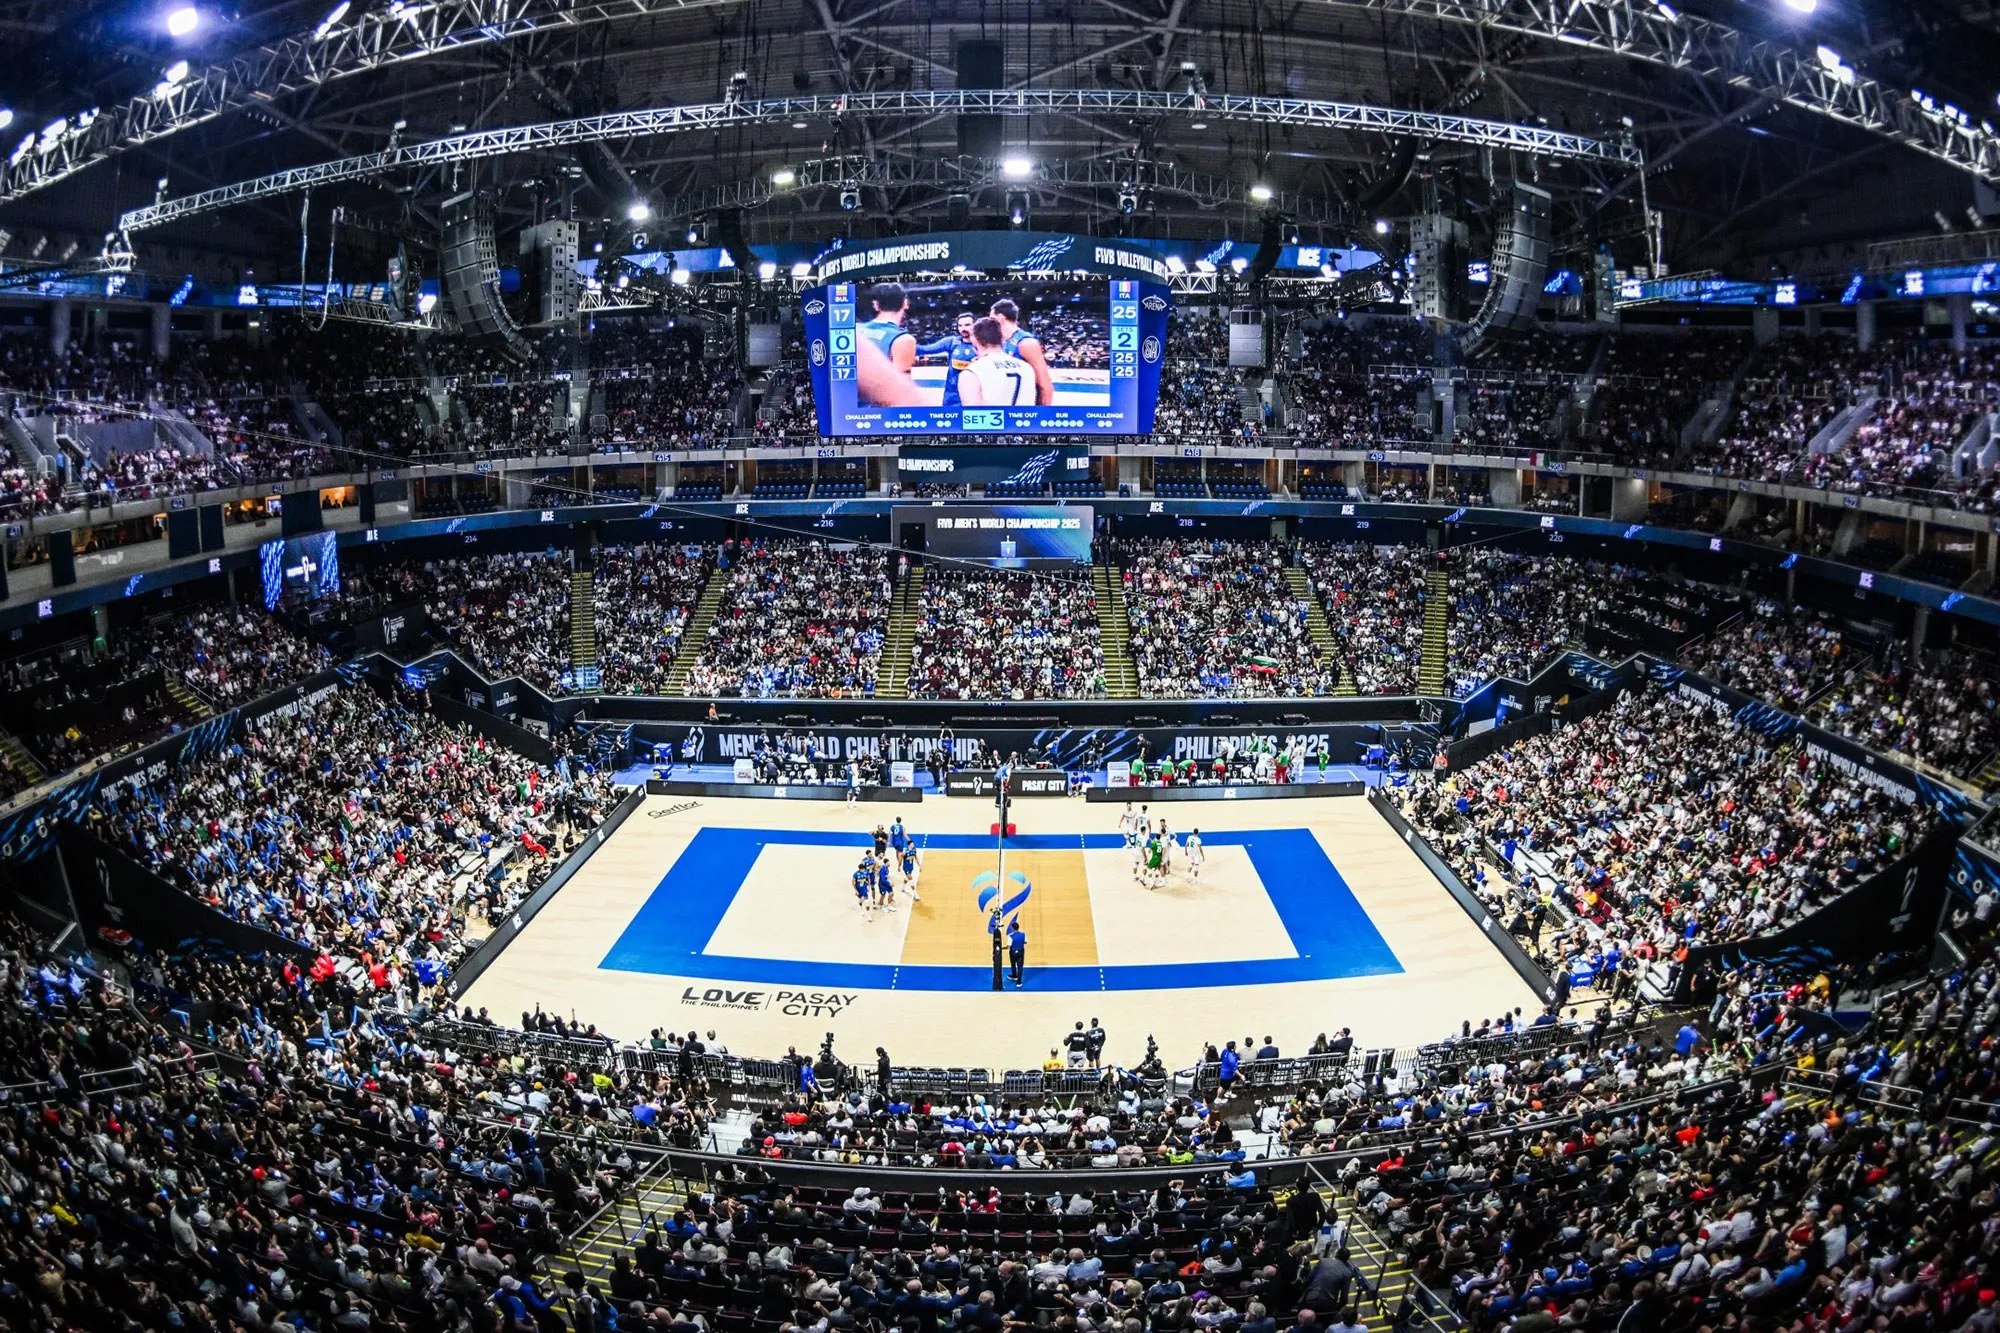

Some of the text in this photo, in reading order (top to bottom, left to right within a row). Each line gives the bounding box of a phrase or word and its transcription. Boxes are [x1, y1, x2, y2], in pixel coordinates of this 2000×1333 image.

[841, 252, 865, 272] WORLD
[867, 242, 950, 266] CHAMPIONSHIPS
[1095, 247, 1115, 265] FIVB
[1116, 250, 1153, 273] VOLLEYBALL
[834, 309, 850, 322] 17
[1113, 305, 1136, 319] 25
[836, 335, 850, 350] 0
[1118, 332, 1131, 348] 2
[837, 355, 850, 365] 21
[1115, 352, 1134, 363] 25
[837, 368, 850, 379] 17
[1115, 366, 1134, 377] 25
[963, 412, 1003, 426] SET 3
[820, 449, 834, 457] 416
[736, 503, 749, 514] ACE
[1150, 502, 1164, 513] ACE
[1341, 504, 1355, 515] ACE
[541, 511, 555, 522] ACE
[660, 521, 673, 529] 215
[937, 518, 1081, 528] FIVB MEN'S WORLD CHAMPIONSHIP 2025
[1549, 534, 1563, 542] 220
[1022, 780, 1066, 791] PASAY CITY
[647, 801, 703, 819] Gerflor
[682, 987, 858, 1006] LOVE PASAY
[701, 1001, 759, 1012] PHILIPPINES
[782, 1004, 843, 1018] CITY
